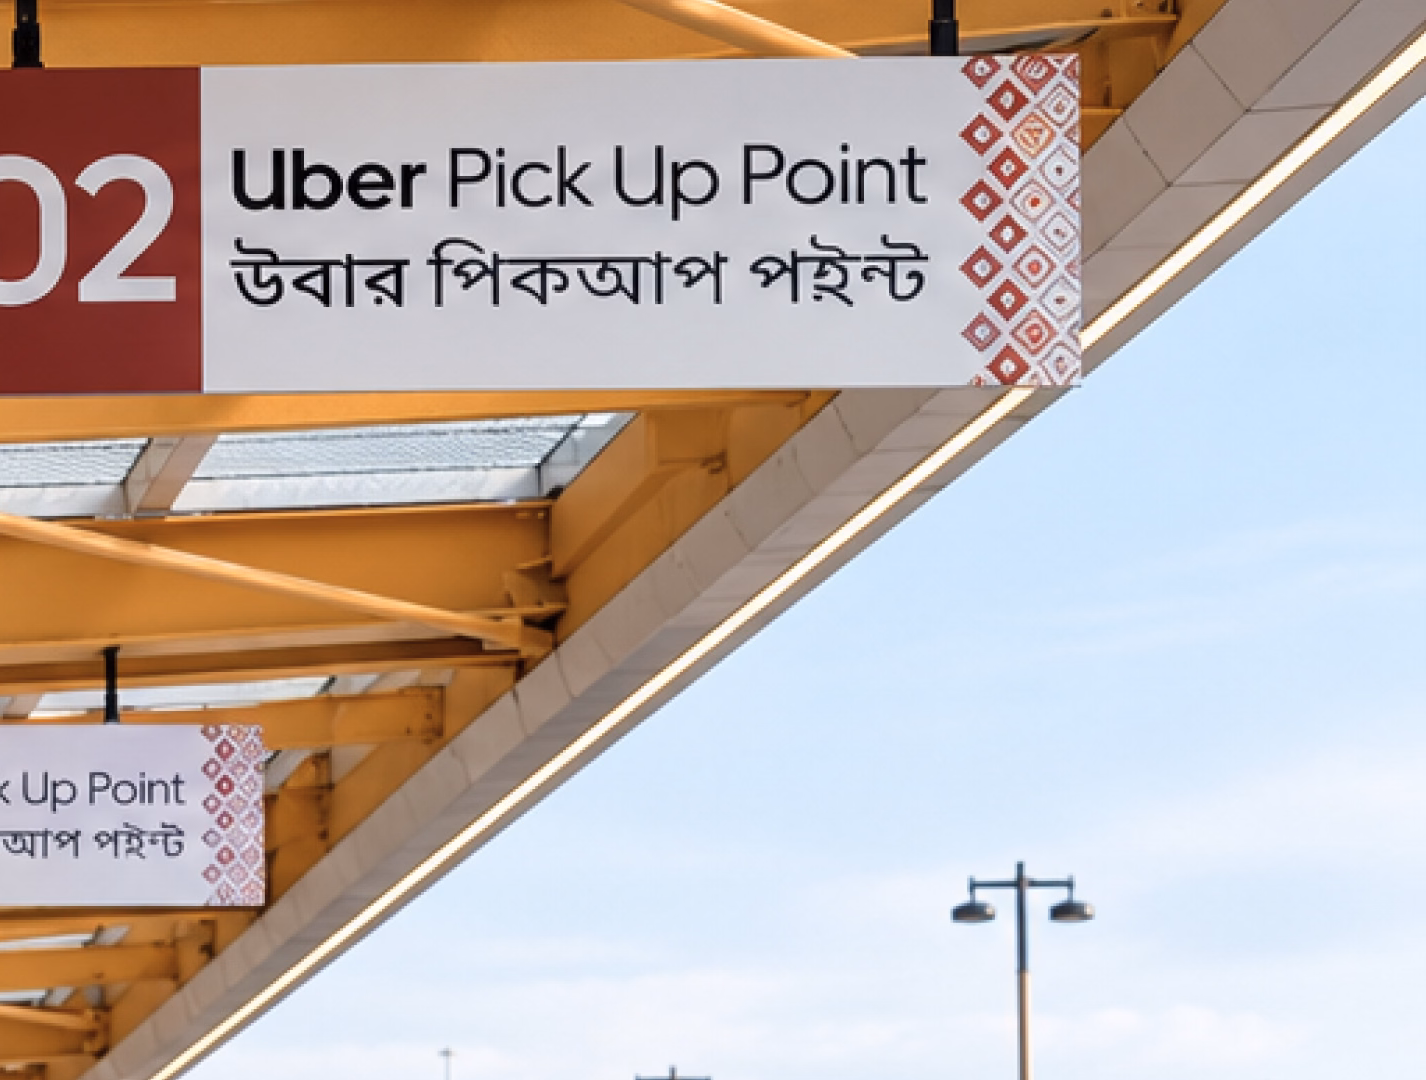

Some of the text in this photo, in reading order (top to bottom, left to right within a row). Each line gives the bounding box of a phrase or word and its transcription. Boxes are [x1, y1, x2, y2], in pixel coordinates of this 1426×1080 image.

[232, 143, 928, 221] Uber Pick Up Point
[229, 237, 410, 307] উবার
[426, 237, 728, 307] পিকআপ
[23, 772, 76, 814] Up
[89, 772, 184, 805] Point
